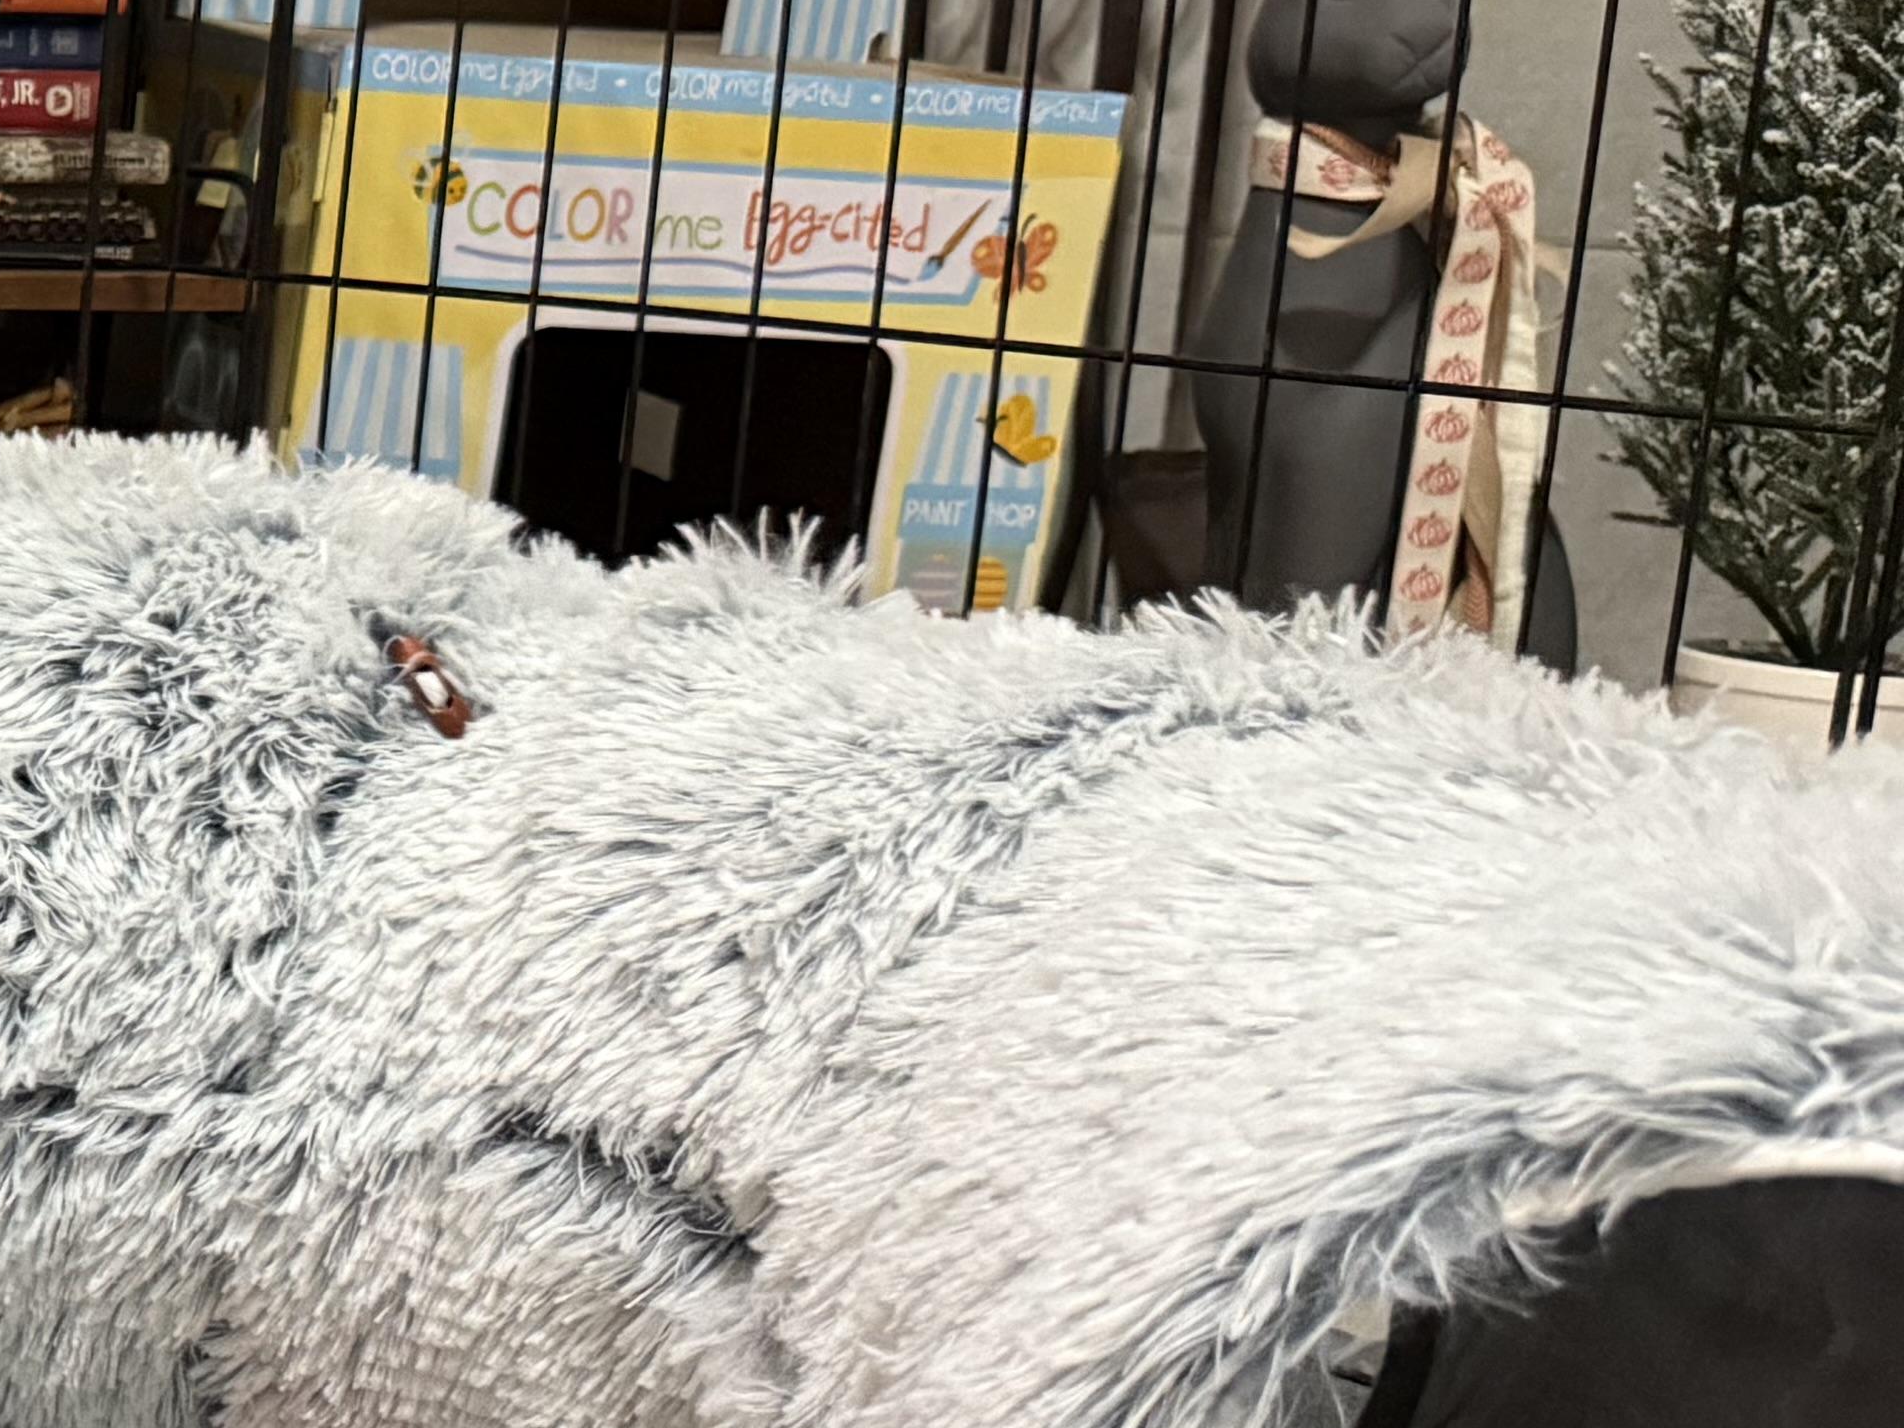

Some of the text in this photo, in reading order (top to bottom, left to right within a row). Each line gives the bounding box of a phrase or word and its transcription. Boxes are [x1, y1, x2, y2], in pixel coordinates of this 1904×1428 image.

[372, 54, 452, 85] COLOR
[464, 61, 497, 83] me
[645, 72, 722, 100] COLOR
[724, 79, 759, 98] me
[903, 86, 972, 117] COLOR
[976, 93, 1011, 112] me
[466, 181, 635, 244] COLOR
[653, 214, 723, 251] me
[904, 498, 1036, 529] PAINT HOP
